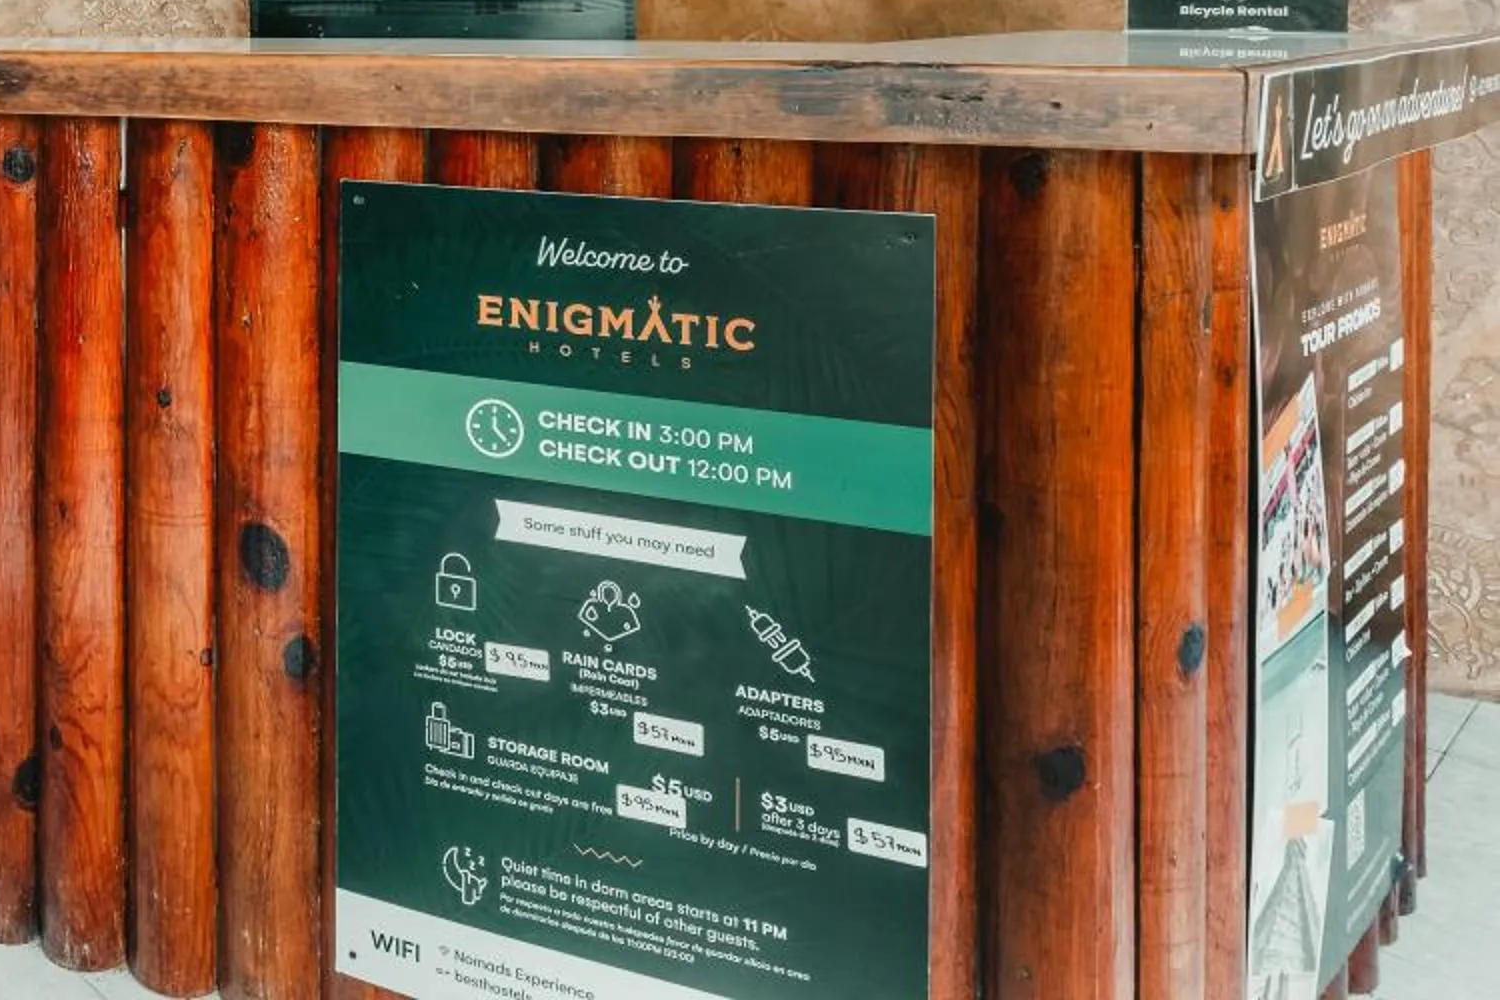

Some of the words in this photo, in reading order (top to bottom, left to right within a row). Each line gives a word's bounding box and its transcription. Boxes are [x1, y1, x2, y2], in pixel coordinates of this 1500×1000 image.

[1179, 4, 1234, 19] Bicycle
[1237, 5, 1289, 18] Rental
[1300, 92, 1345, 160] Let's
[536, 234, 654, 274] Welcome
[659, 246, 690, 275] to
[476, 293, 757, 352] ENIGMATIC
[1300, 321, 1337, 357] TOUR
[529, 340, 692, 369] HOTELS
[538, 409, 620, 439] CHECK
[627, 419, 653, 444] IN
[658, 424, 712, 450] 3:00
[718, 431, 754, 456] PM
[539, 438, 622, 469] CHECK
[628, 449, 681, 477] OUT
[688, 457, 749, 486] 12:00
[757, 466, 793, 491] PM
[523, 516, 565, 538] Some
[568, 521, 603, 543] stuff
[605, 530, 633, 551] you
[636, 536, 672, 556] may
[674, 541, 716, 560] need
[435, 627, 477, 646] LOCK
[562, 650, 599, 670] RAIN
[602, 658, 657, 681] CARDS
[735, 684, 825, 713] ADAPTERS
[738, 705, 822, 731] ADAPTADORES
[486, 754, 530, 774] GUARDA
[487, 736, 558, 764] STORAGE
[561, 752, 609, 775] ROOM
[470, 773, 491, 787] and
[492, 776, 523, 795] check
[525, 787, 542, 801] out
[544, 791, 570, 808] days
[572, 799, 589, 812] are
[668, 827, 698, 844] Price
[700, 833, 715, 849] by
[717, 838, 739, 856] day
[761, 811, 793, 828] after
[795, 818, 805, 831] 3
[807, 821, 841, 840] days
[501, 856, 538, 877] Quiet
[541, 867, 572, 886] time
[574, 873, 588, 890] in
[590, 877, 630, 900] dorm
[632, 891, 674, 913] areas
[677, 901, 720, 924] starts
[722, 913, 741, 930] at
[743, 916, 759, 934] 11
[760, 922, 788, 941] PM
[501, 874, 547, 898] please
[549, 883, 568, 902] be
[570, 890, 642, 922] respectful
[644, 909, 662, 928] of
[663, 916, 703, 938] other
[706, 927, 761, 952] guests.
[370, 929, 421, 963] WIFI
[454, 950, 512, 977] Nomads
[515, 967, 596, 1000] Experience
